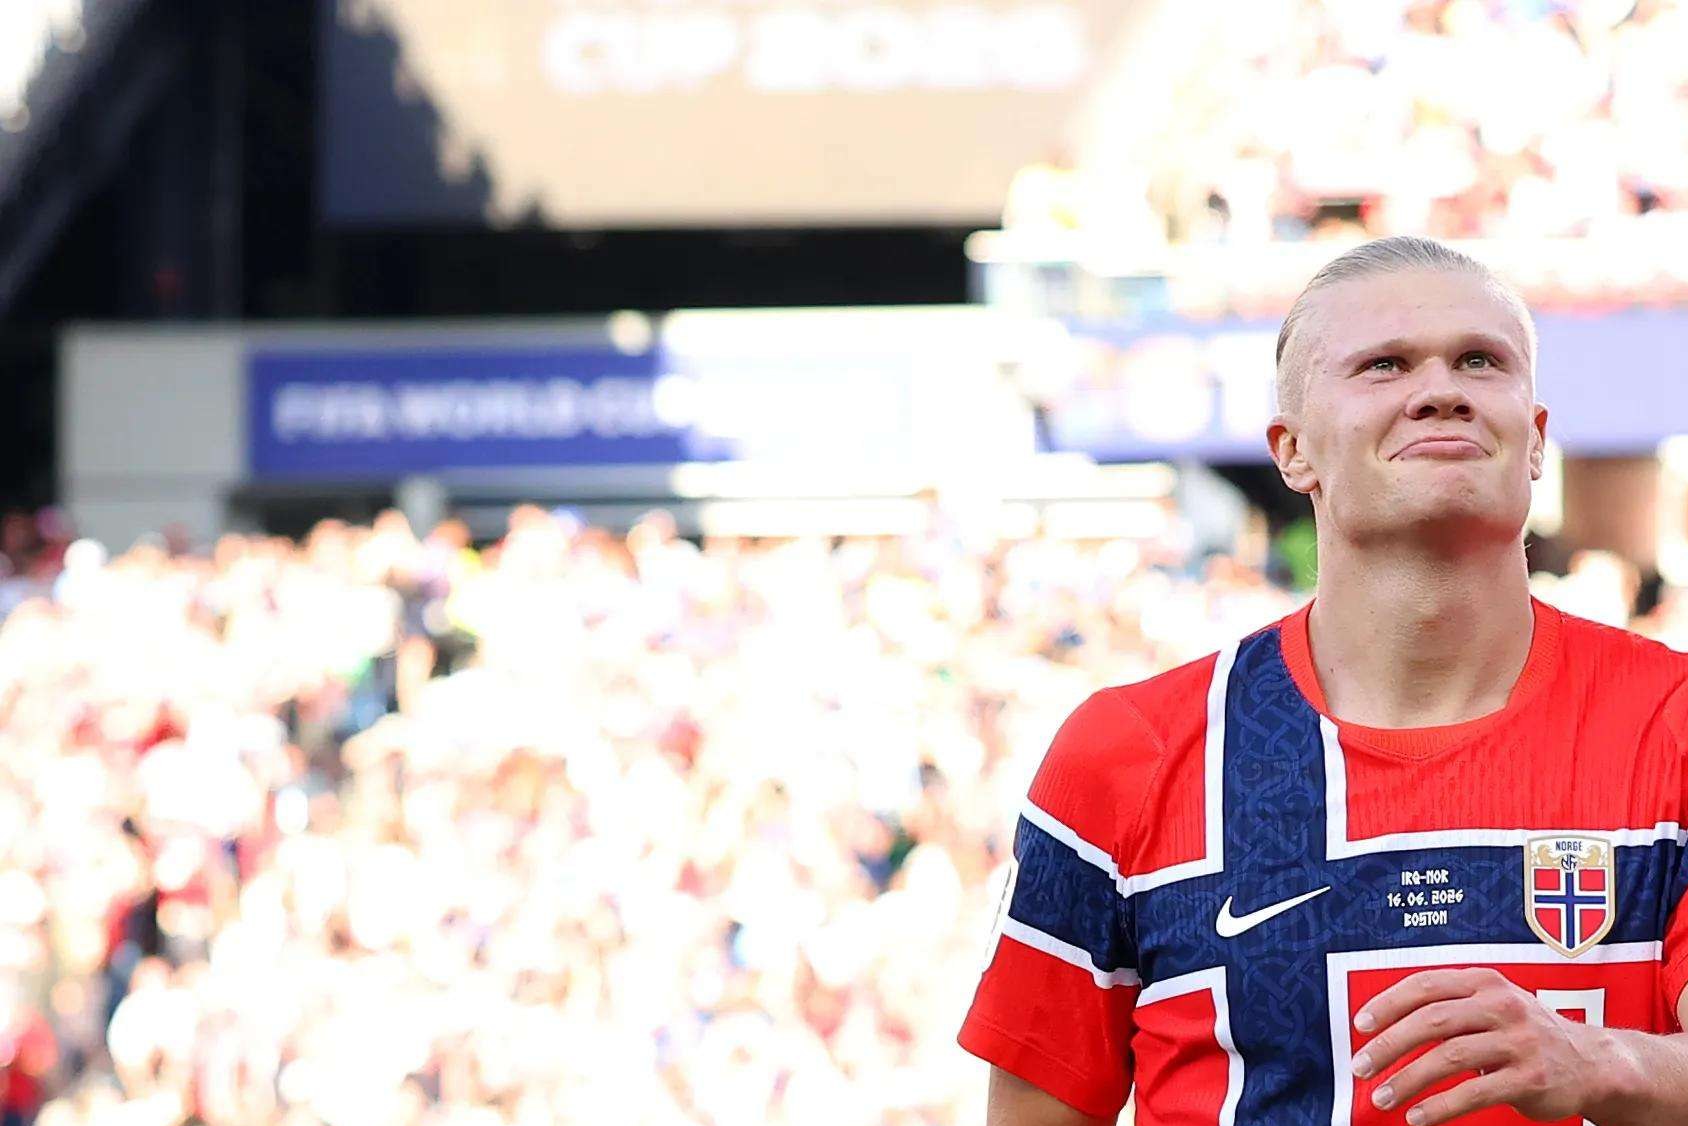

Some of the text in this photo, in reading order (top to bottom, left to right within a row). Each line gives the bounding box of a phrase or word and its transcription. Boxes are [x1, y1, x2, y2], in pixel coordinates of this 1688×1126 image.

[591, 375, 672, 438] CU
[1555, 840, 1583, 852] NORGE
[1401, 869, 1449, 886] IRQ-NOR
[1403, 910, 1448, 928] BOSTON
